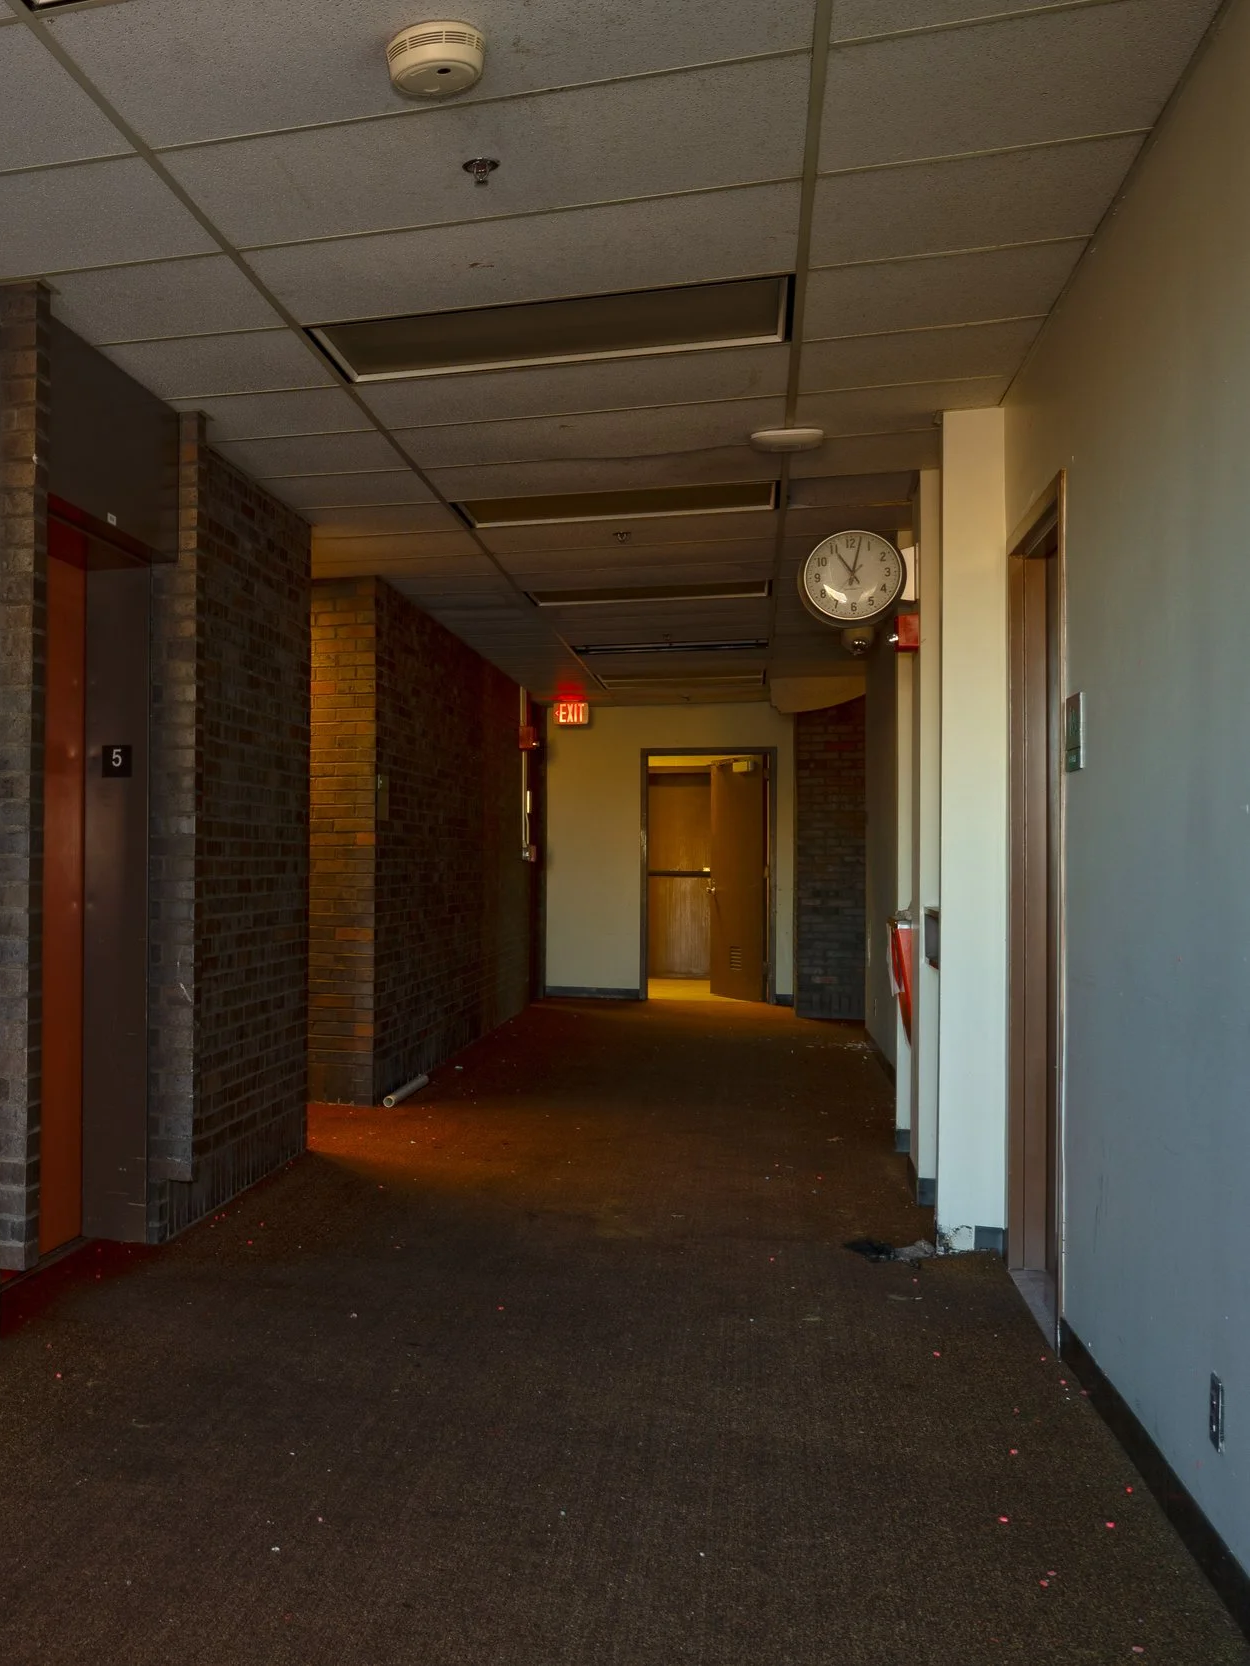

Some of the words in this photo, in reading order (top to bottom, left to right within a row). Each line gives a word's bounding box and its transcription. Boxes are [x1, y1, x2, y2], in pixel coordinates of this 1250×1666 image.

[830, 543, 838, 554] 11
[845, 539, 856, 549] 12
[879, 552, 886, 561] 2
[816, 557, 827, 567] 10
[884, 568, 891, 577] 3
[814, 573, 821, 582] 9
[880, 584, 887, 593] 4
[820, 589, 827, 598] 8
[832, 599, 839, 609] 7
[868, 597, 874, 606] 5
[850, 602, 857, 611] 6
[559, 703, 584, 722] EXIT
[112, 749, 122, 767] 5
